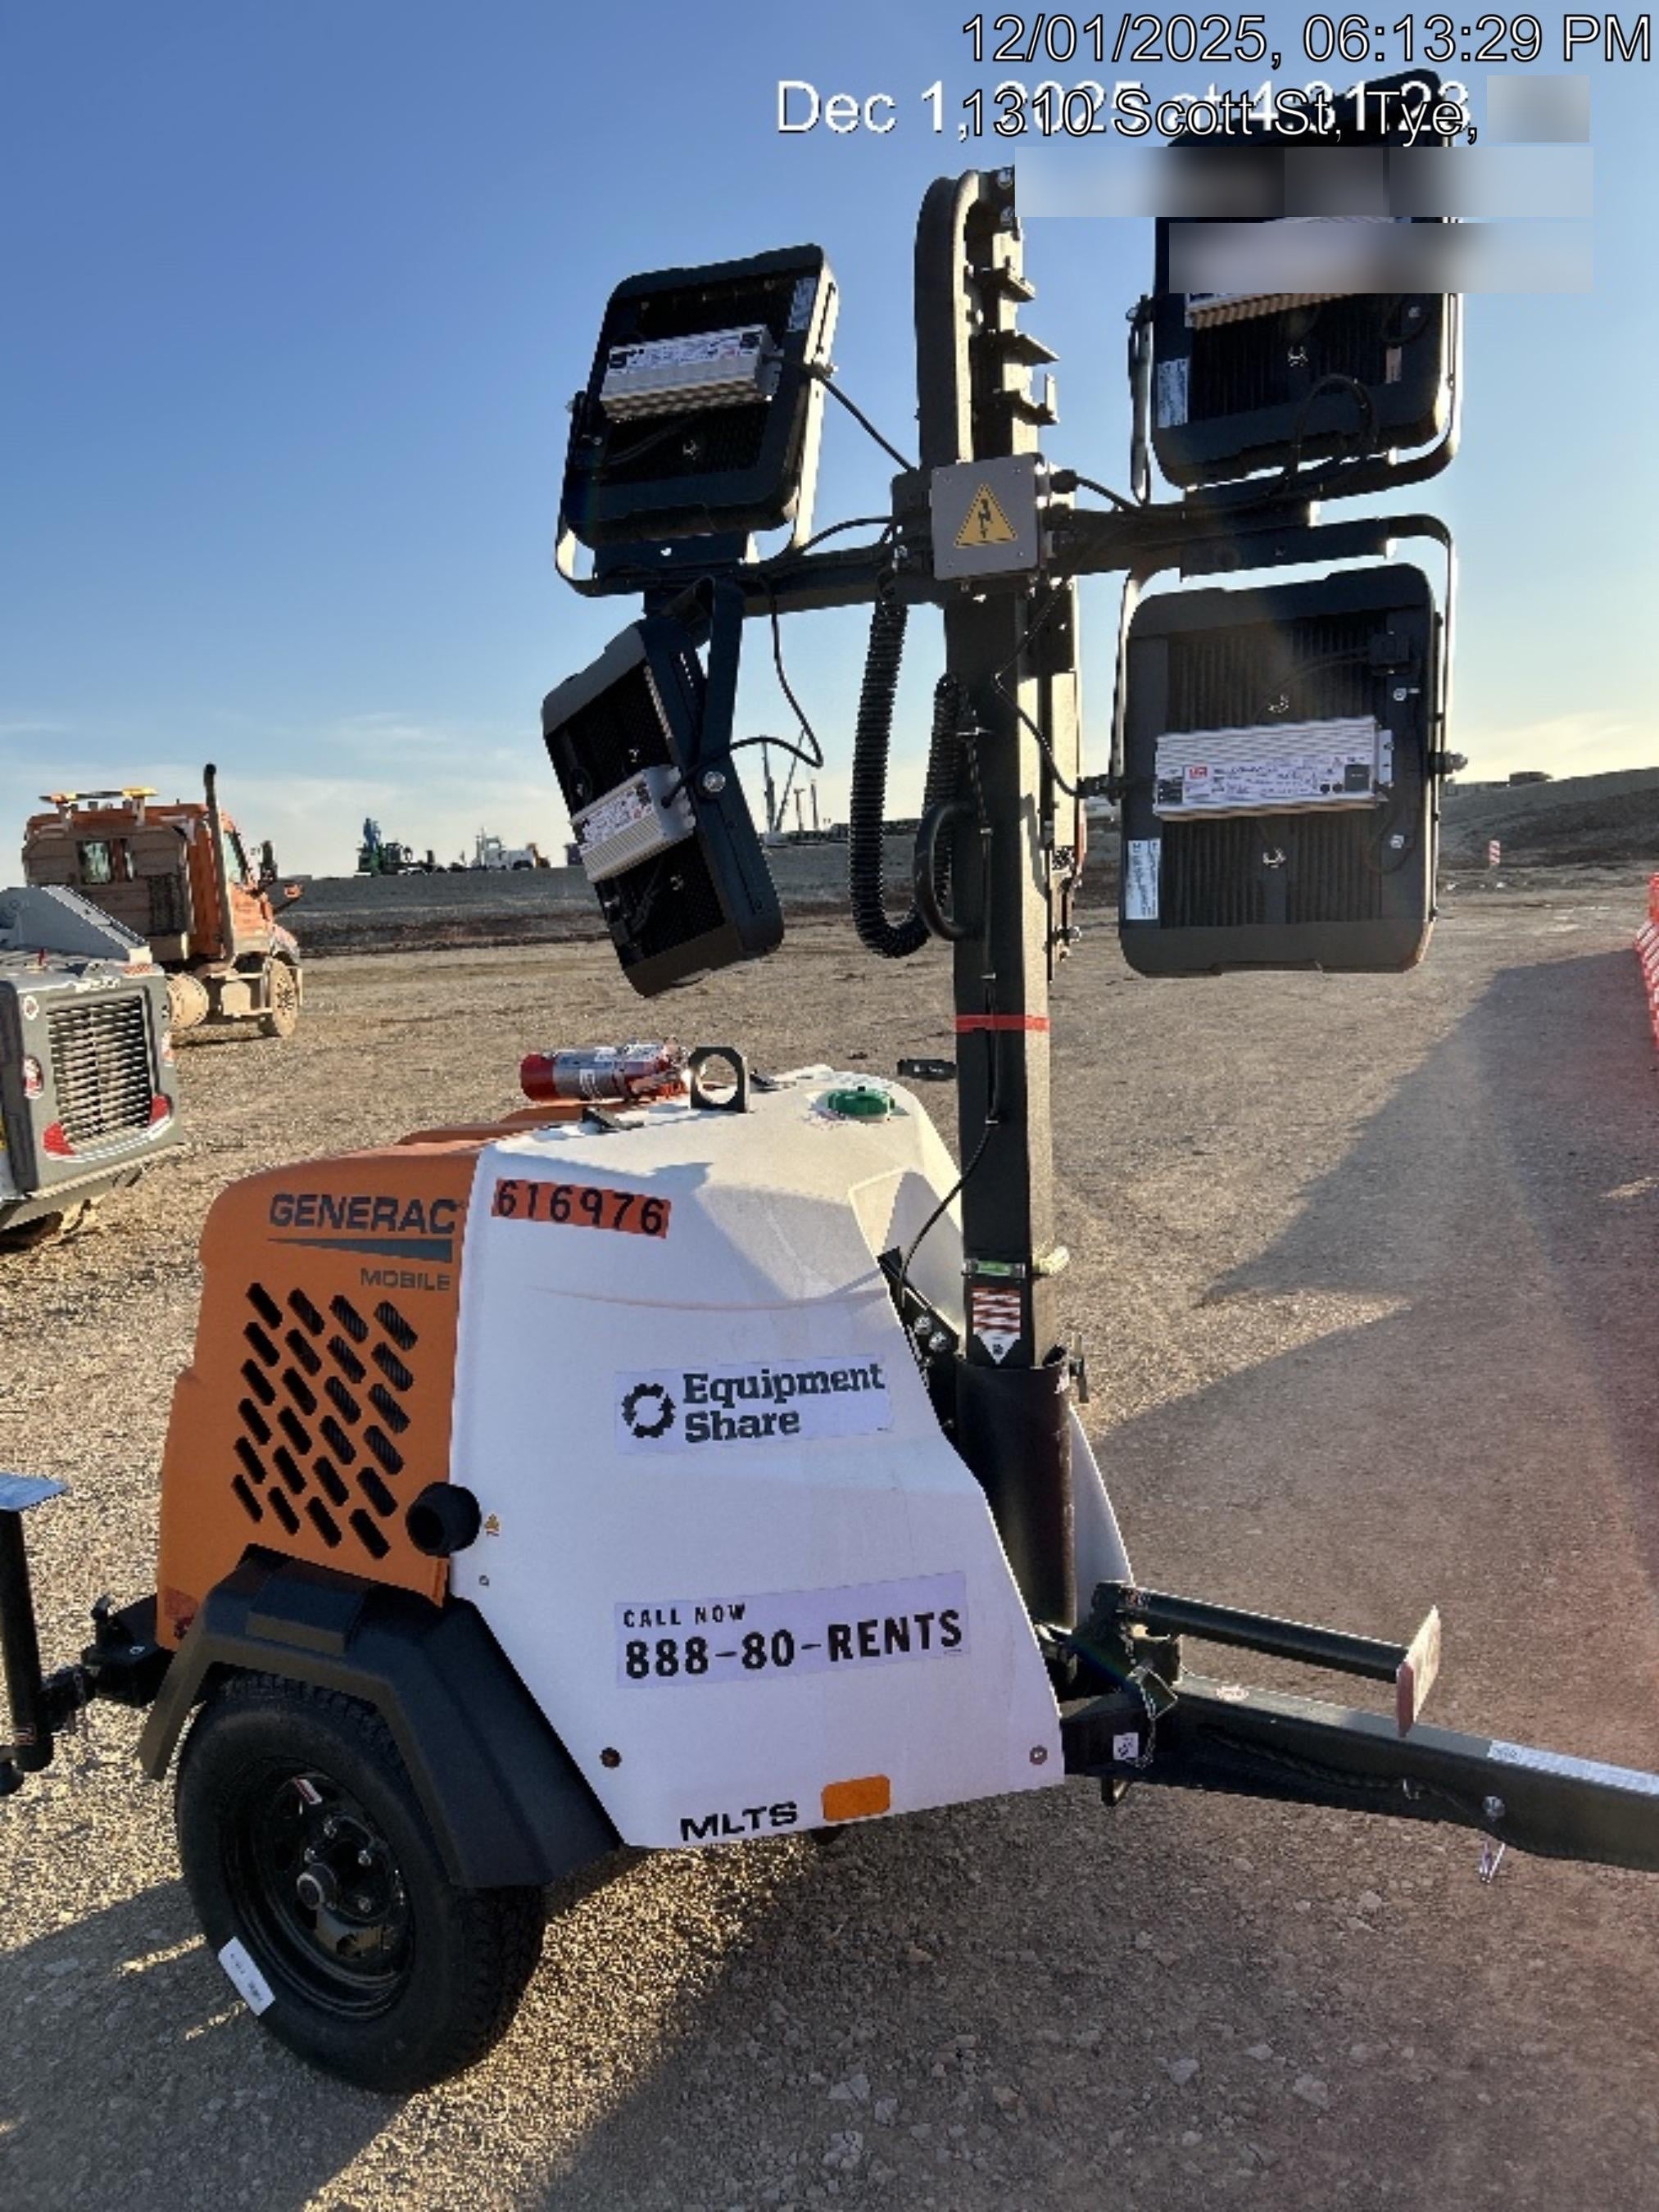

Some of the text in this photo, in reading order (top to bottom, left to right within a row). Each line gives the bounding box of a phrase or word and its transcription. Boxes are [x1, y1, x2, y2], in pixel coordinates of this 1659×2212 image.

[270, 1193, 456, 1235] GENERAC
[496, 1180, 666, 1236] 616976
[360, 1267, 451, 1292] MOBILE
[682, 1363, 886, 1409] Equipment
[685, 1410, 801, 1444] Share
[623, 1603, 746, 1629] CALL NOW
[625, 1608, 963, 1679] 888-80-RENTS
[680, 1801, 798, 1842] MLTS
